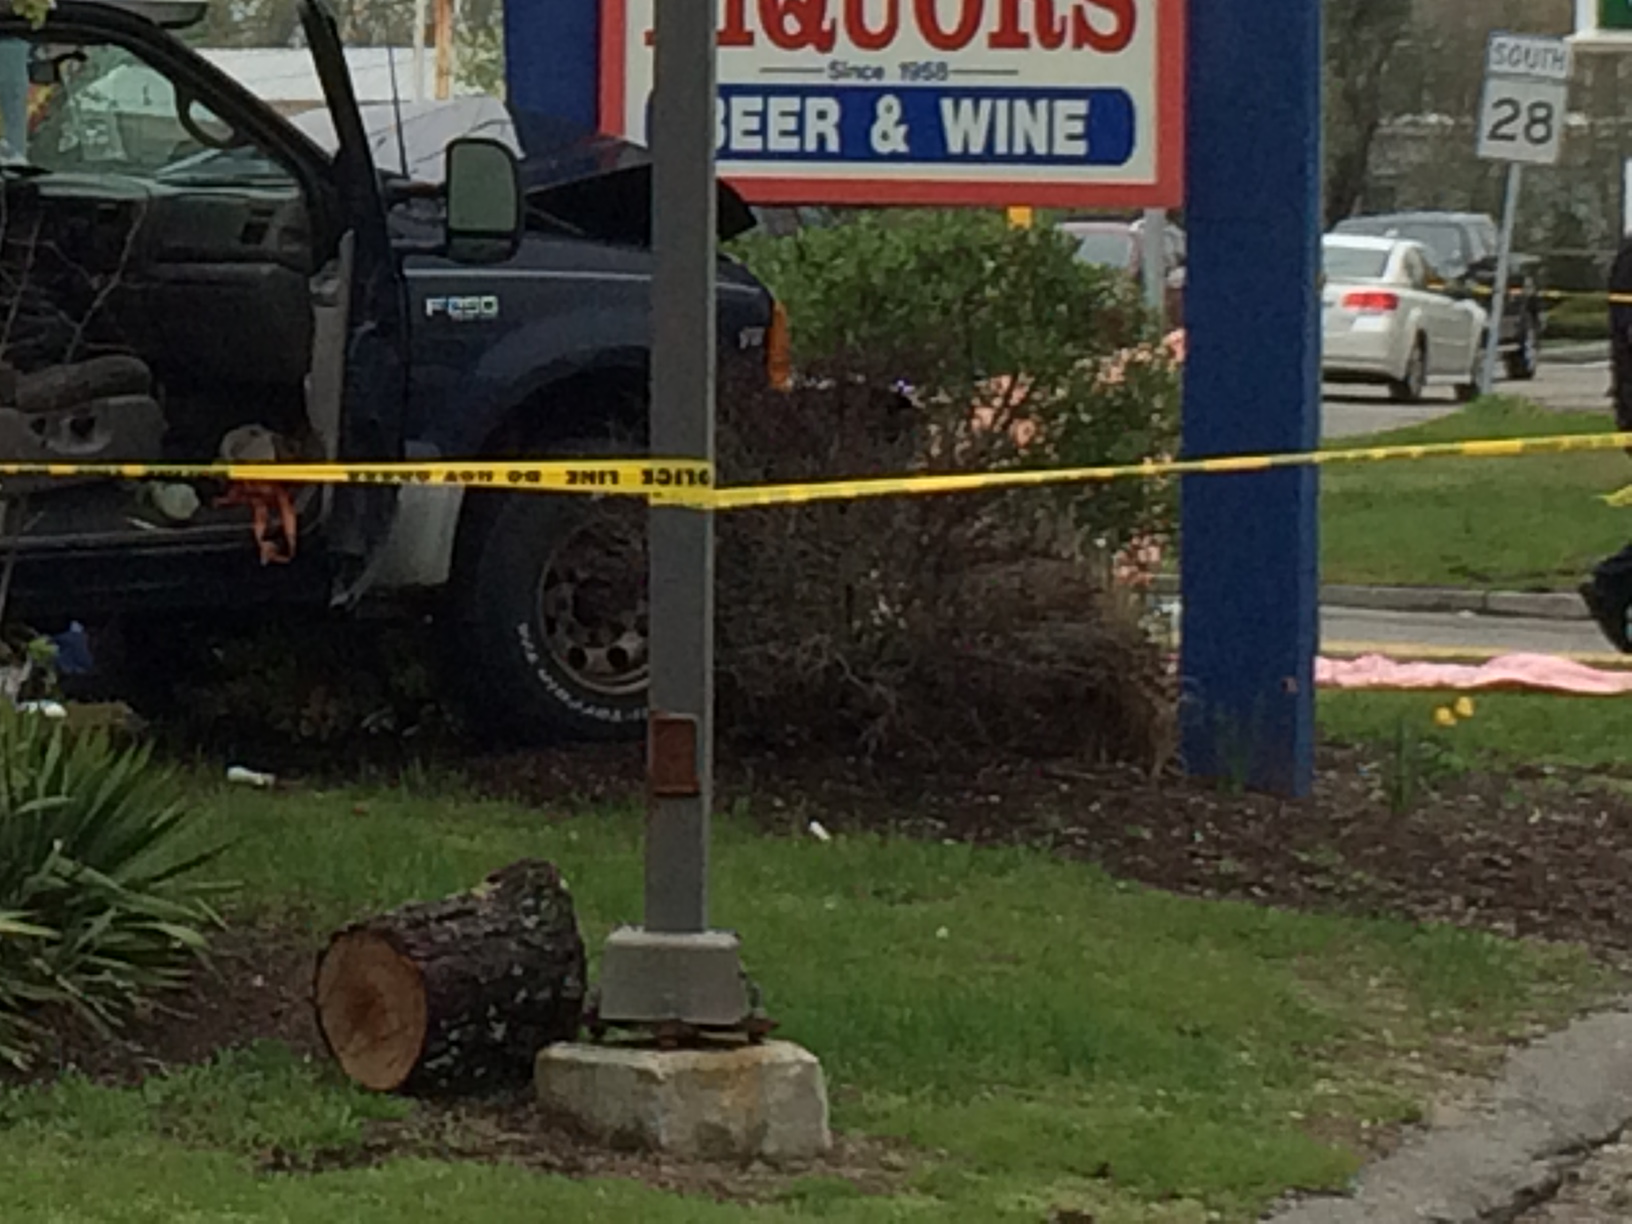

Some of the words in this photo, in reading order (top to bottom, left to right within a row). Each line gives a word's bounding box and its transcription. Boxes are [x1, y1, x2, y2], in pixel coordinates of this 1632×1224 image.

[1492, 40, 1566, 70] SOUTH
[869, 95, 909, 153] &
[939, 95, 1091, 156] WINE
[1486, 97, 1555, 146] 28
